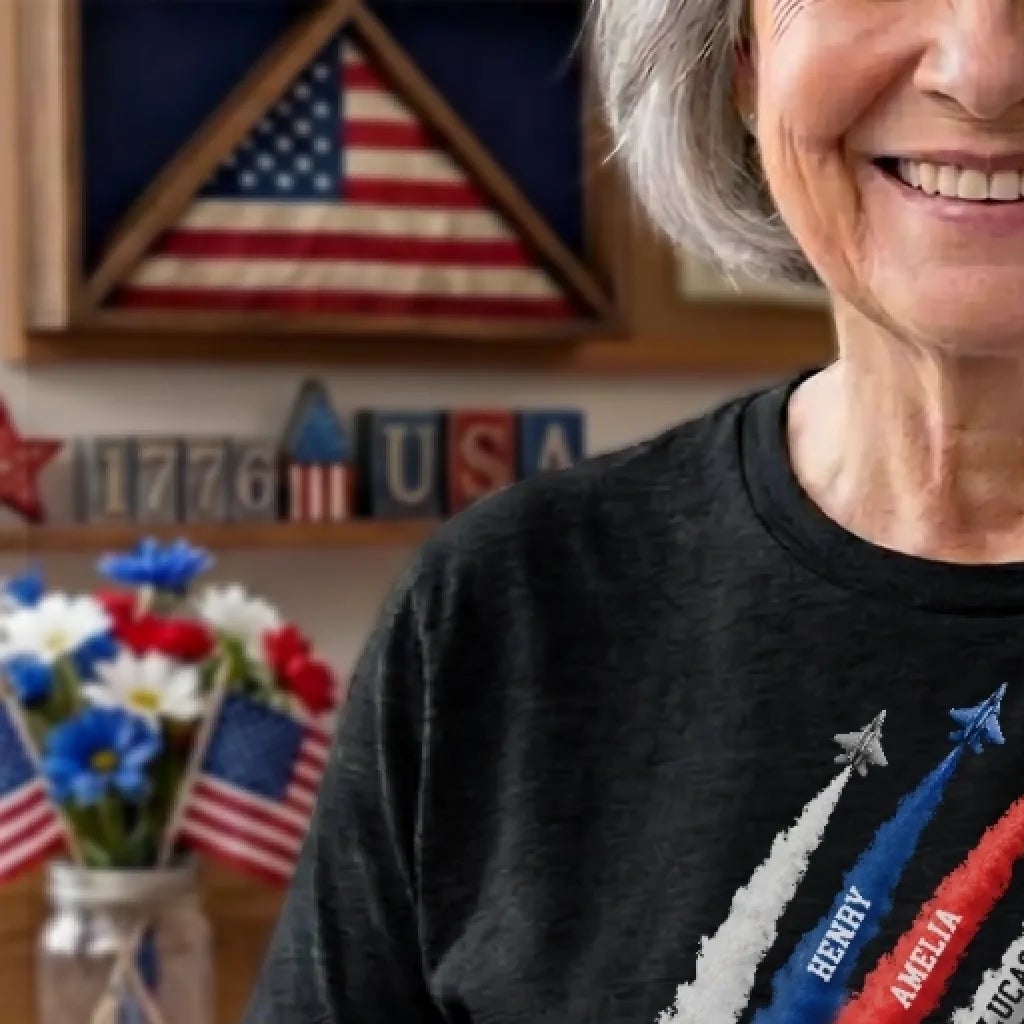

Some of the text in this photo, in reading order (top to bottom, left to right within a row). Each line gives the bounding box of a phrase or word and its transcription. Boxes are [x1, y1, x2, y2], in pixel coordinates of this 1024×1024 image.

[100, 441, 275, 514] 1776
[807, 885, 871, 983] HENRY
[890, 909, 963, 1009] AMELIA
